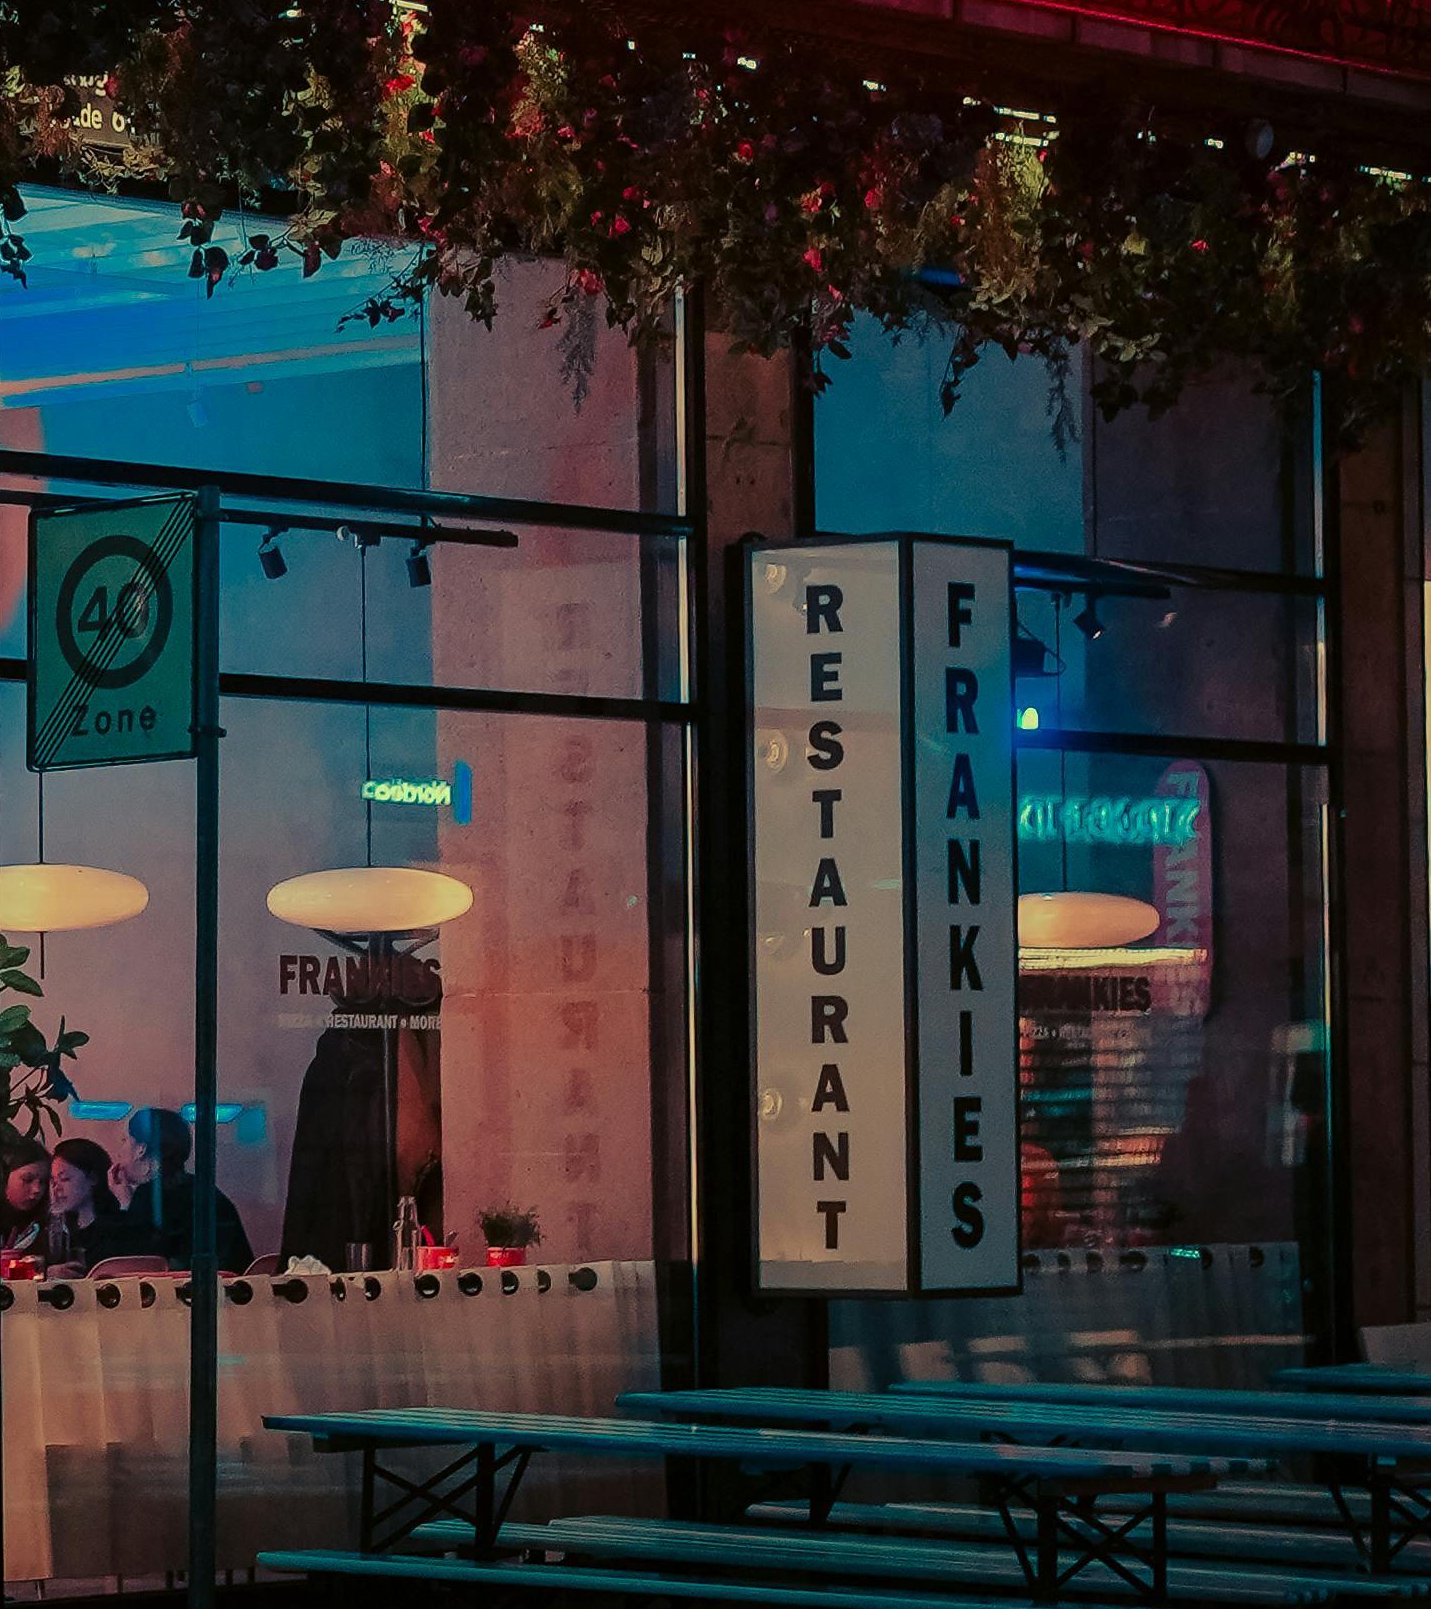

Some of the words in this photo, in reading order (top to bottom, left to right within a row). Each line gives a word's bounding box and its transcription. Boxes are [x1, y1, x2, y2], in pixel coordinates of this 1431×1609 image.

[72, 704, 158, 738] Zone
[77, 583, 150, 640] 40
[805, 583, 850, 1251] RESTAURANT
[943, 581, 984, 1250] FRANKIES
